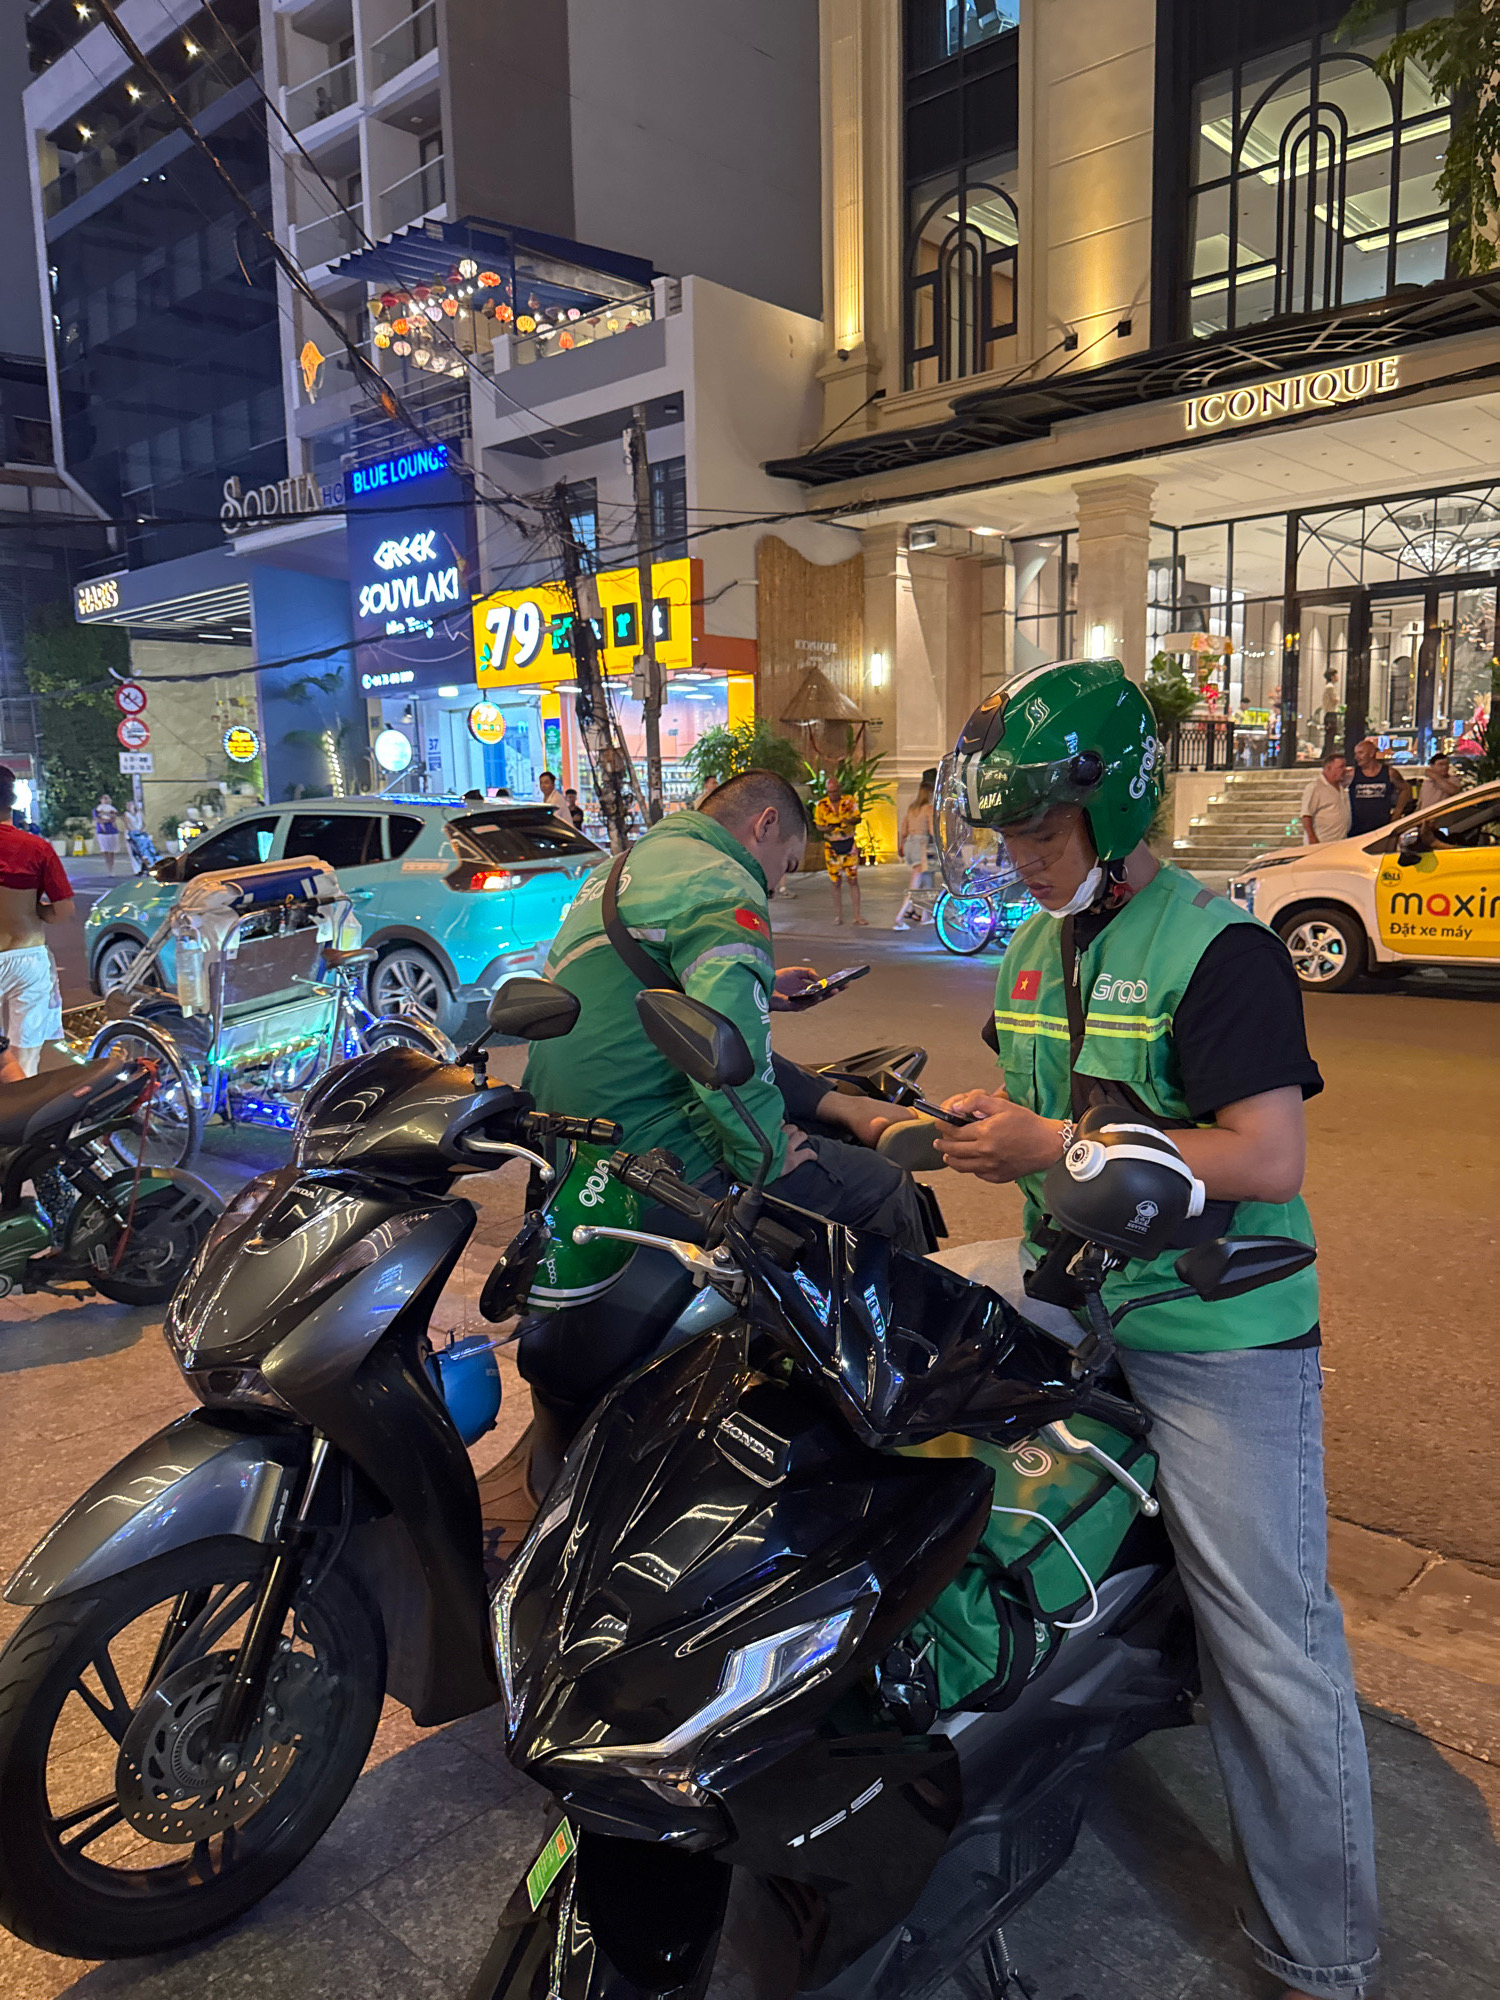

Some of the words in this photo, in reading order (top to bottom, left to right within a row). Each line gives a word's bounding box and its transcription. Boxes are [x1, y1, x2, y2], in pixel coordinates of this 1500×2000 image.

[1186, 356, 1399, 431] ICONIQUE
[353, 463, 388, 494] BLUE
[373, 529, 437, 570] GREEK
[359, 566, 459, 618] SOUVLAKI
[485, 601, 543, 669] 79
[1129, 735, 1158, 800] Grab
[1389, 922, 1417, 938] Đặt
[1419, 926, 1438, 937] xe
[1441, 925, 1474, 941] máy
[718, 1418, 775, 1465] HONDA
[786, 1776, 884, 1848] 125
